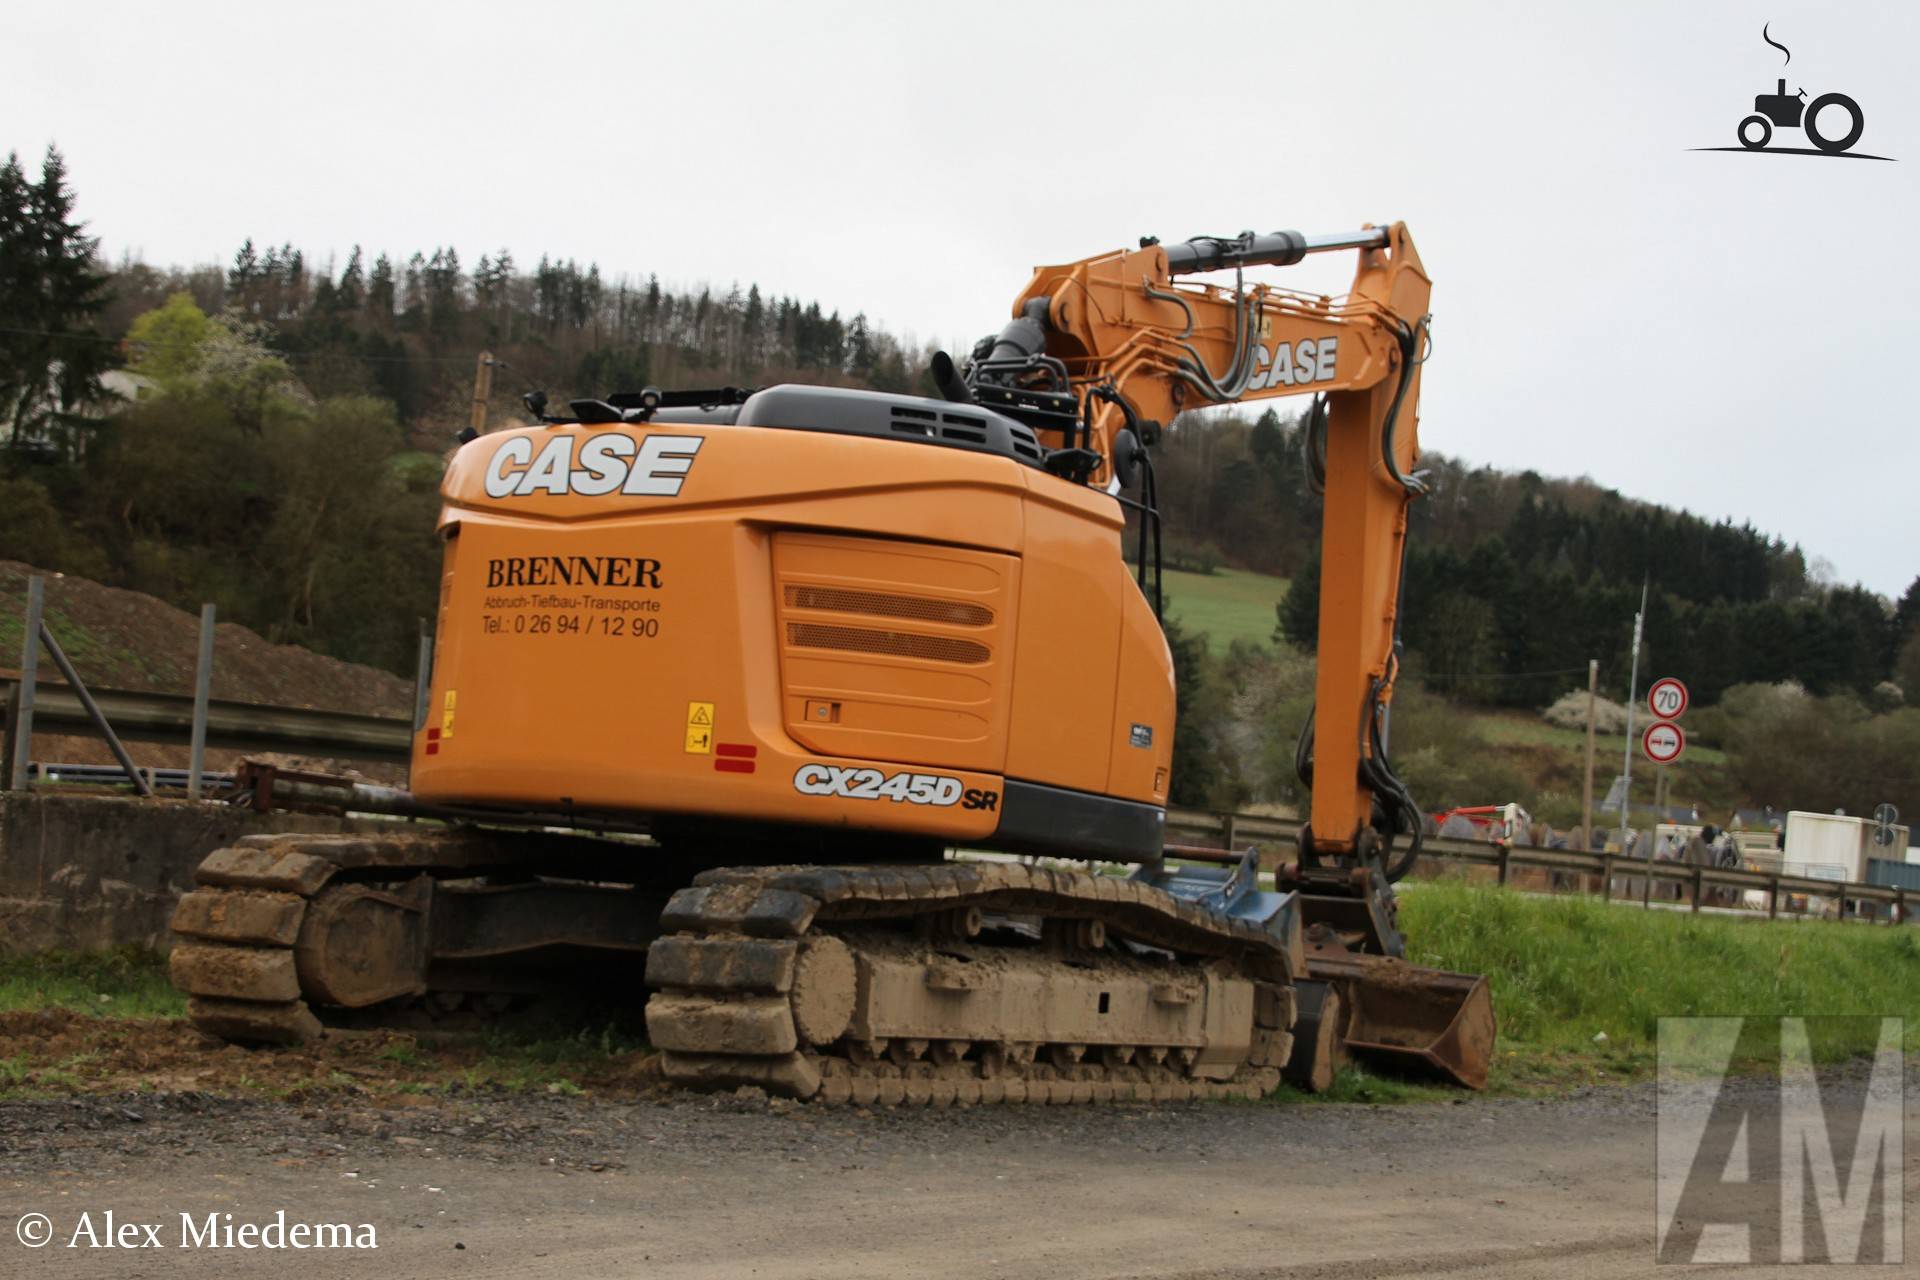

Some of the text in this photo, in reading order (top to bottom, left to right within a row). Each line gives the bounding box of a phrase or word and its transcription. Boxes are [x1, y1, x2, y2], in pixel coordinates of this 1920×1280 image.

[1246, 336, 1338, 391] CASE
[484, 433, 705, 498] CASE
[487, 556, 663, 589] BRENNER
[514, 614, 525, 634] 0
[529, 614, 551, 634] 26
[556, 614, 579, 634] 94
[601, 616, 625, 636] 12
[631, 617, 659, 638] 90
[1658, 690, 1678, 709] 70
[793, 763, 998, 811] CX245D SR
